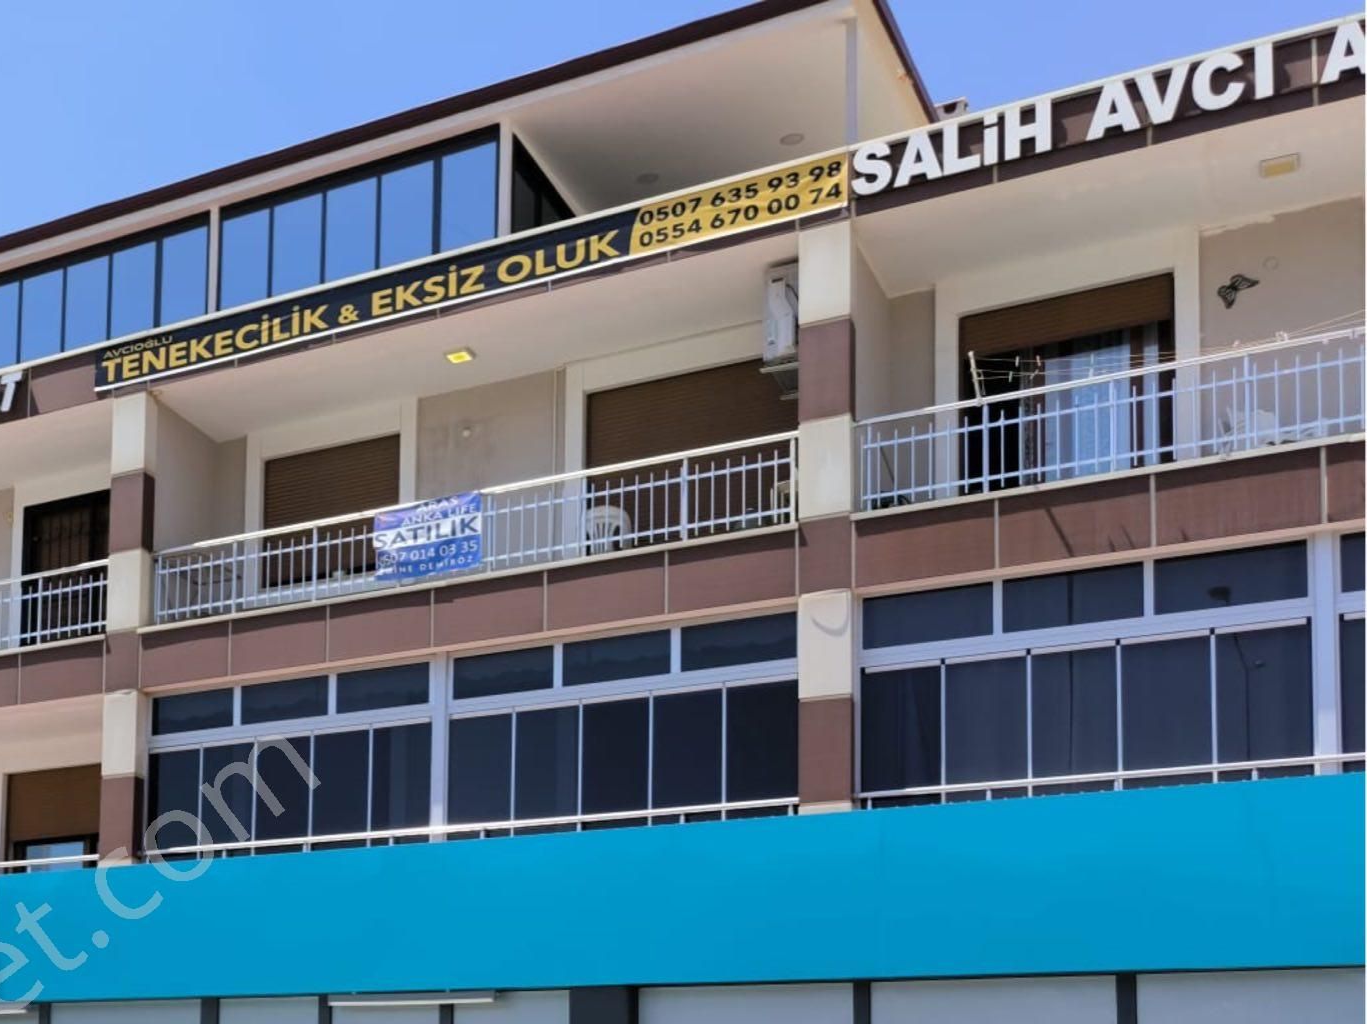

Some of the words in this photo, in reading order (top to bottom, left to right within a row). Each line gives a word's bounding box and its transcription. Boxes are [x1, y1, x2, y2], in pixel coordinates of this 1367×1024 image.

[1086, 42, 1275, 142] AVCI
[638, 197, 703, 226] 0507
[710, 182, 760, 208] 635
[767, 172, 800, 193] 93
[809, 160, 843, 183] 98
[638, 218, 703, 248] 0554
[710, 204, 760, 230] 670
[766, 194, 801, 216] 00
[809, 182, 843, 206] 74
[100, 303, 330, 384] TENEKECİLİK
[337, 303, 361, 325] &
[370, 264, 485, 317] EKSİZ
[496, 229, 621, 284] OLUK
[374, 515, 479, 549] SATILIK
[439, 543, 457, 557] 03
[462, 540, 479, 552] 35
